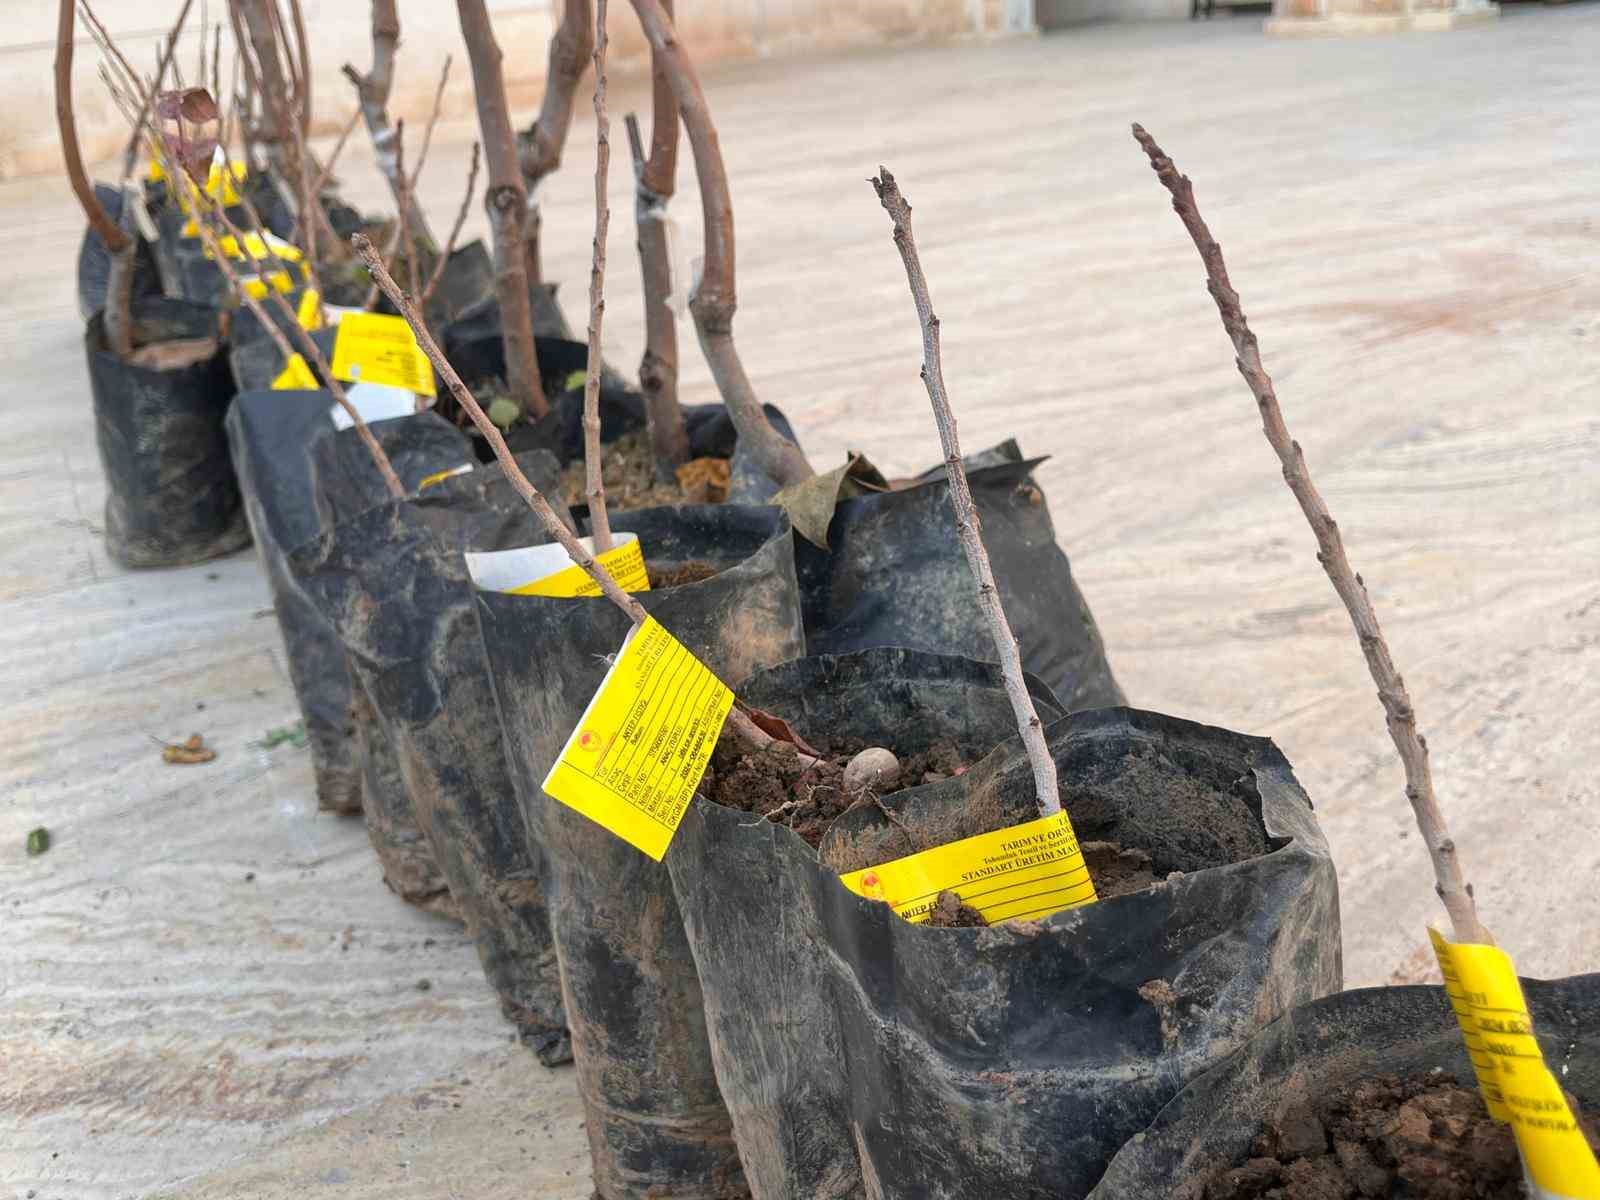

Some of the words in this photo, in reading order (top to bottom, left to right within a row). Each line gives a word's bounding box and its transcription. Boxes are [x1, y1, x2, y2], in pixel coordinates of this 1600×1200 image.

[1000, 837, 1031, 851] TARIM
[1031, 833, 1045, 843] VE
[961, 861, 1013, 880] STANDART
[1015, 850, 1054, 867] ÜRETİM
